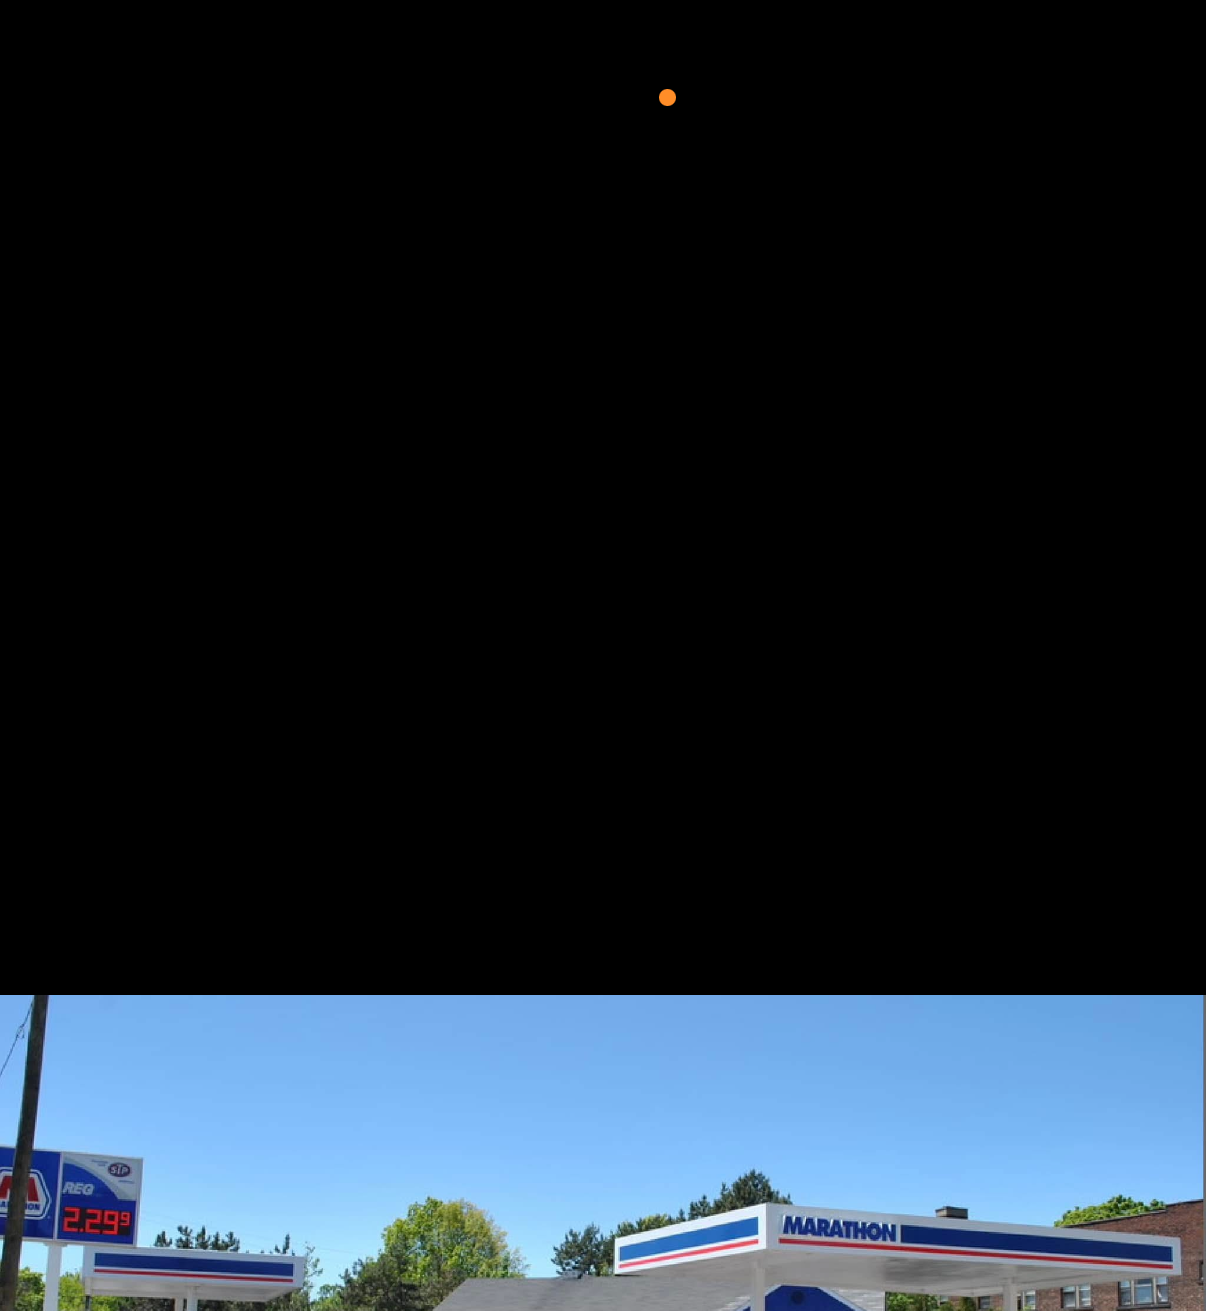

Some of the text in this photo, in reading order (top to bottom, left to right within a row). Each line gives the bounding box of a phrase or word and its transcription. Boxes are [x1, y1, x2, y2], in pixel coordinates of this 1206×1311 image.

[110, 1165, 129, 1175] STP
[62, 1182, 95, 1196] REG
[782, 1215, 897, 1242] MARATHON
